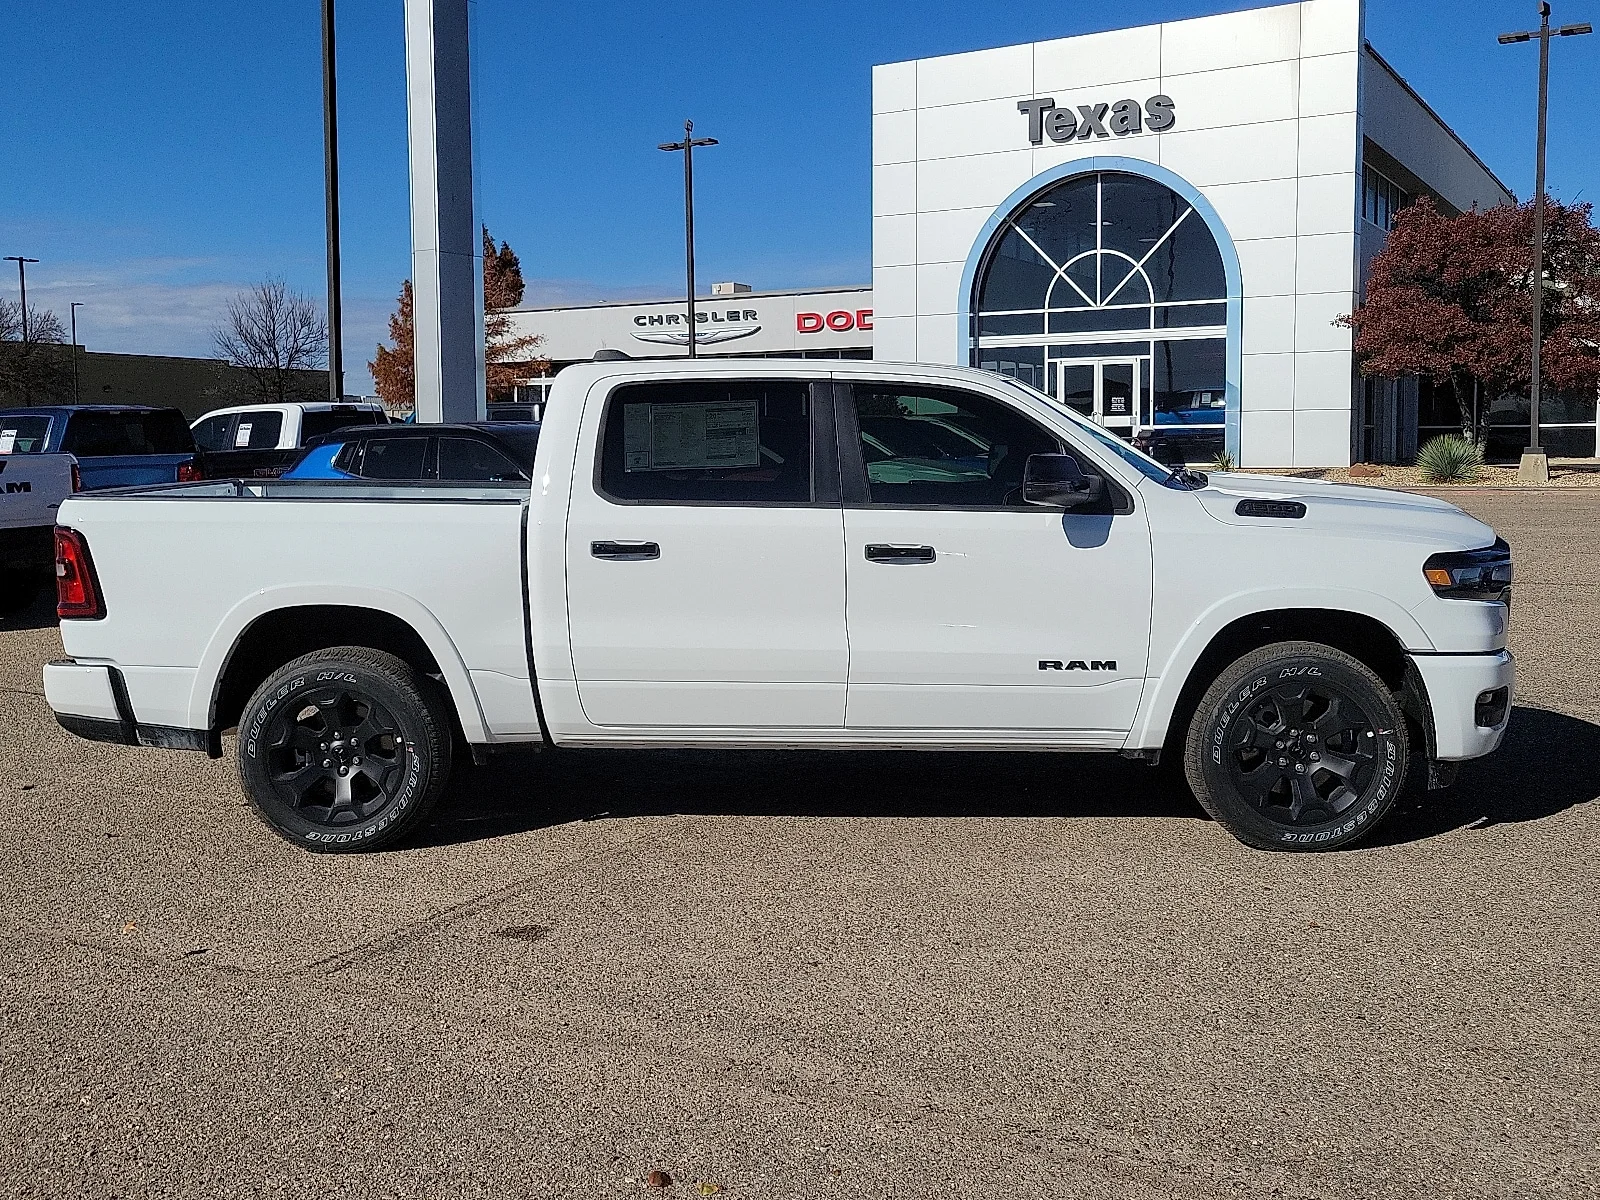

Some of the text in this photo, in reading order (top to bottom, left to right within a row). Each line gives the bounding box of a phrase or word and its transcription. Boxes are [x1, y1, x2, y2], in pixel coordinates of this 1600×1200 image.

[1017, 94, 1176, 146] Texas
[1038, 660, 1118, 671] RAM
[248, 671, 357, 758] DUELER H/L
[1212, 666, 1322, 764] DUELER H/L
[306, 753, 420, 843] BRIDGESTONE
[1281, 740, 1396, 843] BRIDGESTONE
